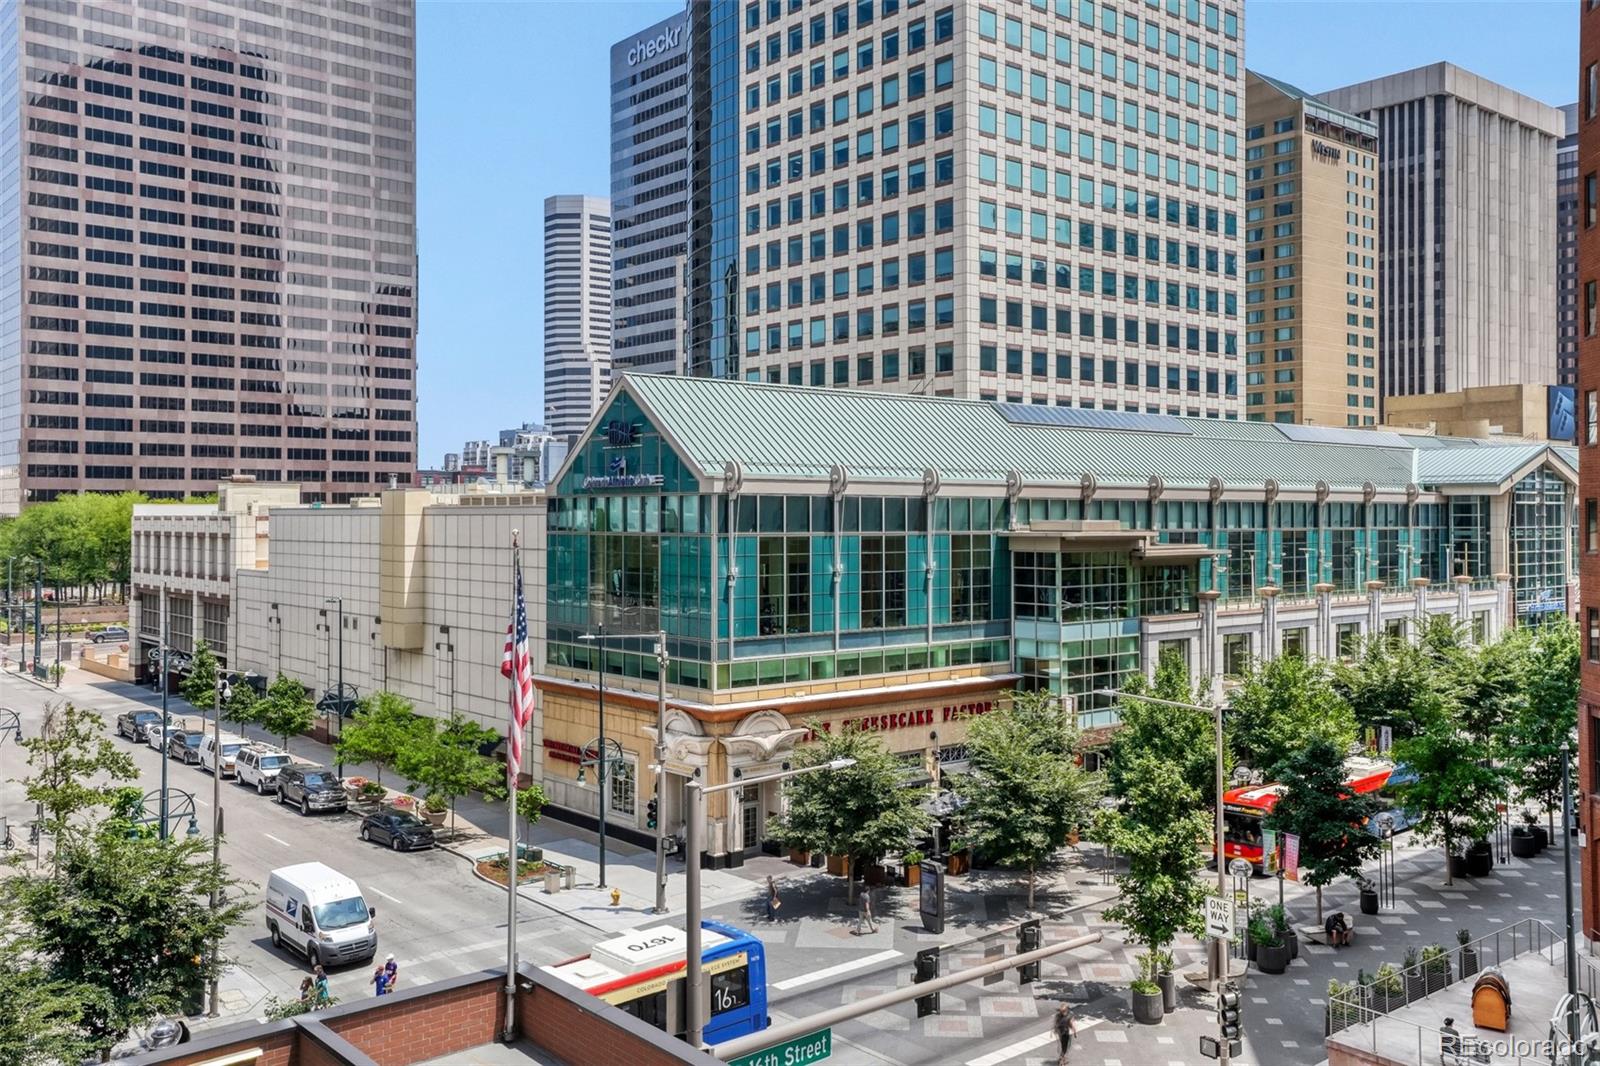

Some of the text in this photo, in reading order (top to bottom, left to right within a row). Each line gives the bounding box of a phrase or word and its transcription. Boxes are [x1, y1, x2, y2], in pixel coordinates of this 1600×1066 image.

[627, 26, 683, 67] checkr
[842, 709, 934, 735] CEESECAKE
[1209, 899, 1229, 913] ONE
[1210, 910, 1230, 924] WAY
[627, 936, 676, 951] 1670
[784, 1034, 828, 1066] Street
